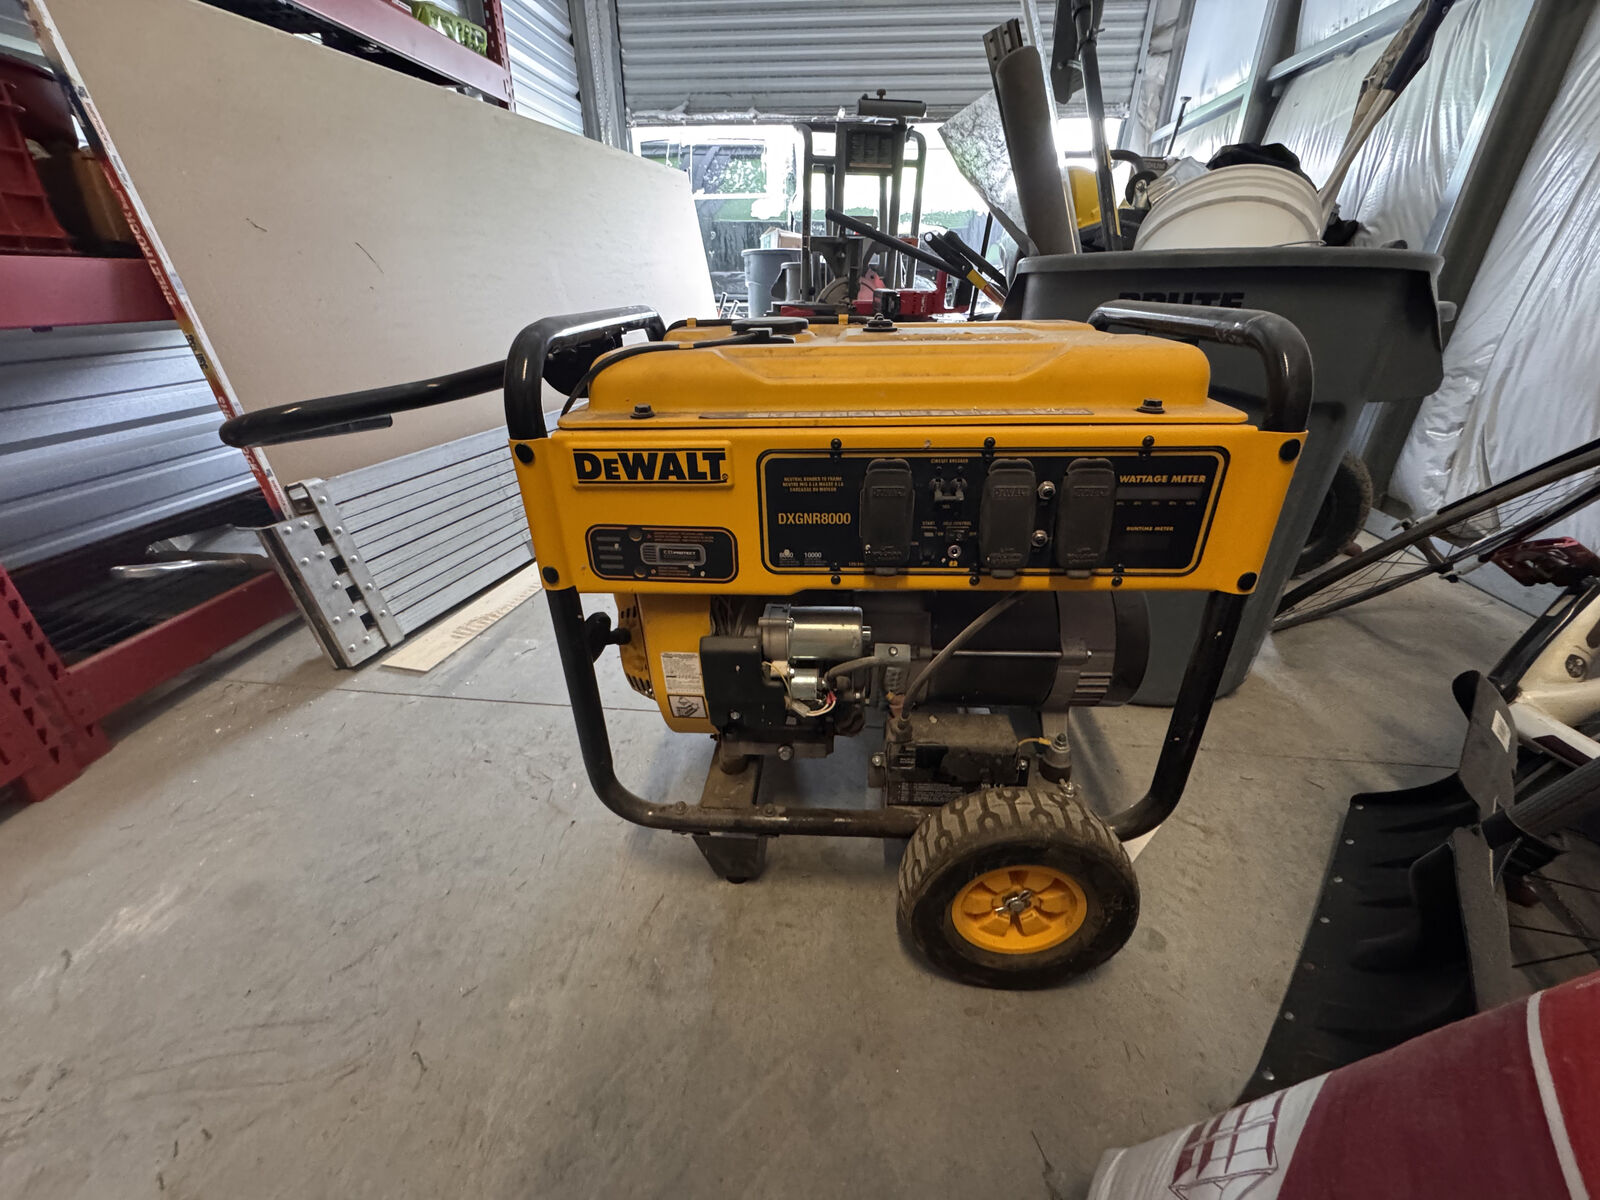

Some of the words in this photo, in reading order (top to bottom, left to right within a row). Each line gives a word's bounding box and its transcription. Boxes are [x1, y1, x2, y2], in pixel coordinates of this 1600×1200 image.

[1119, 474, 1168, 483] WATTAGE
[1170, 474, 1207, 483] METER
[778, 512, 852, 525] DXGNR8000
